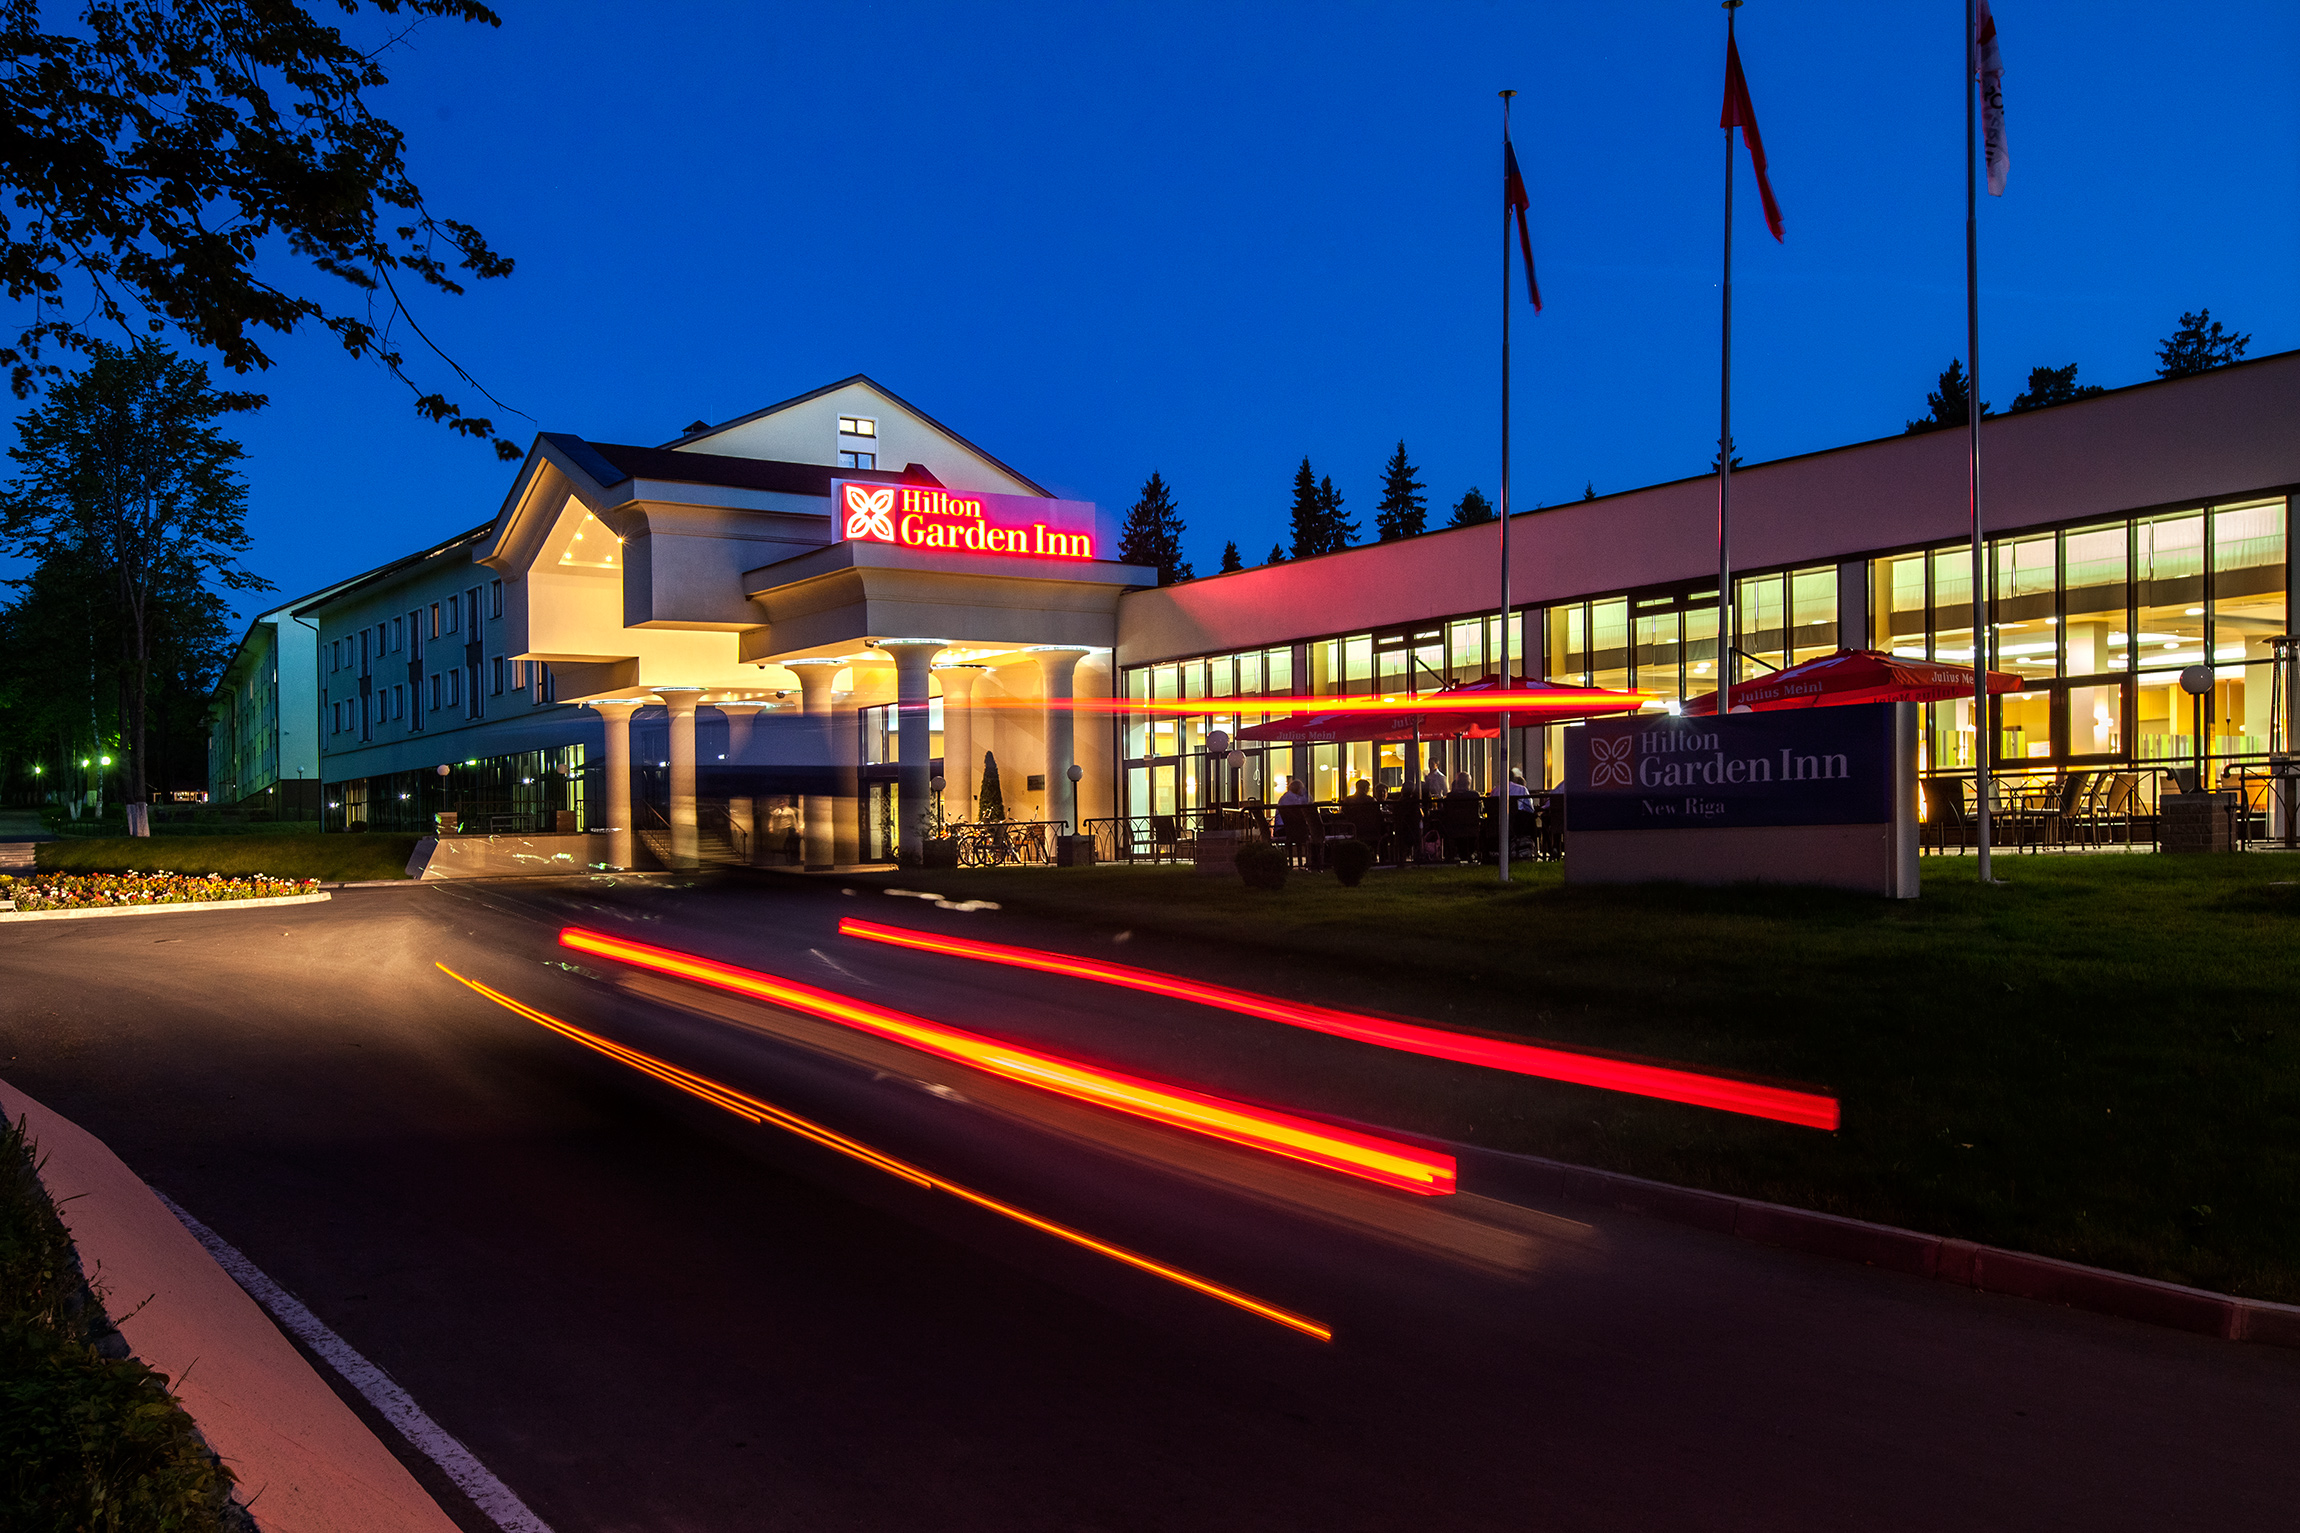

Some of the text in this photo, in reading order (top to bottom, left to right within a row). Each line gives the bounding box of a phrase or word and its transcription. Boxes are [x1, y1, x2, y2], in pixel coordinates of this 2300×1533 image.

[901, 489, 981, 518] Hilton
[900, 514, 1092, 558] Garden Inn
[1931, 671, 1960, 683] Julius
[1737, 681, 1823, 704] Julius Meinl
[1276, 731, 1336, 740] Julius Meinl
[1640, 730, 1720, 754] Hilton
[1639, 748, 1851, 788] Garden Inn
[1641, 797, 1726, 819] New Riga
